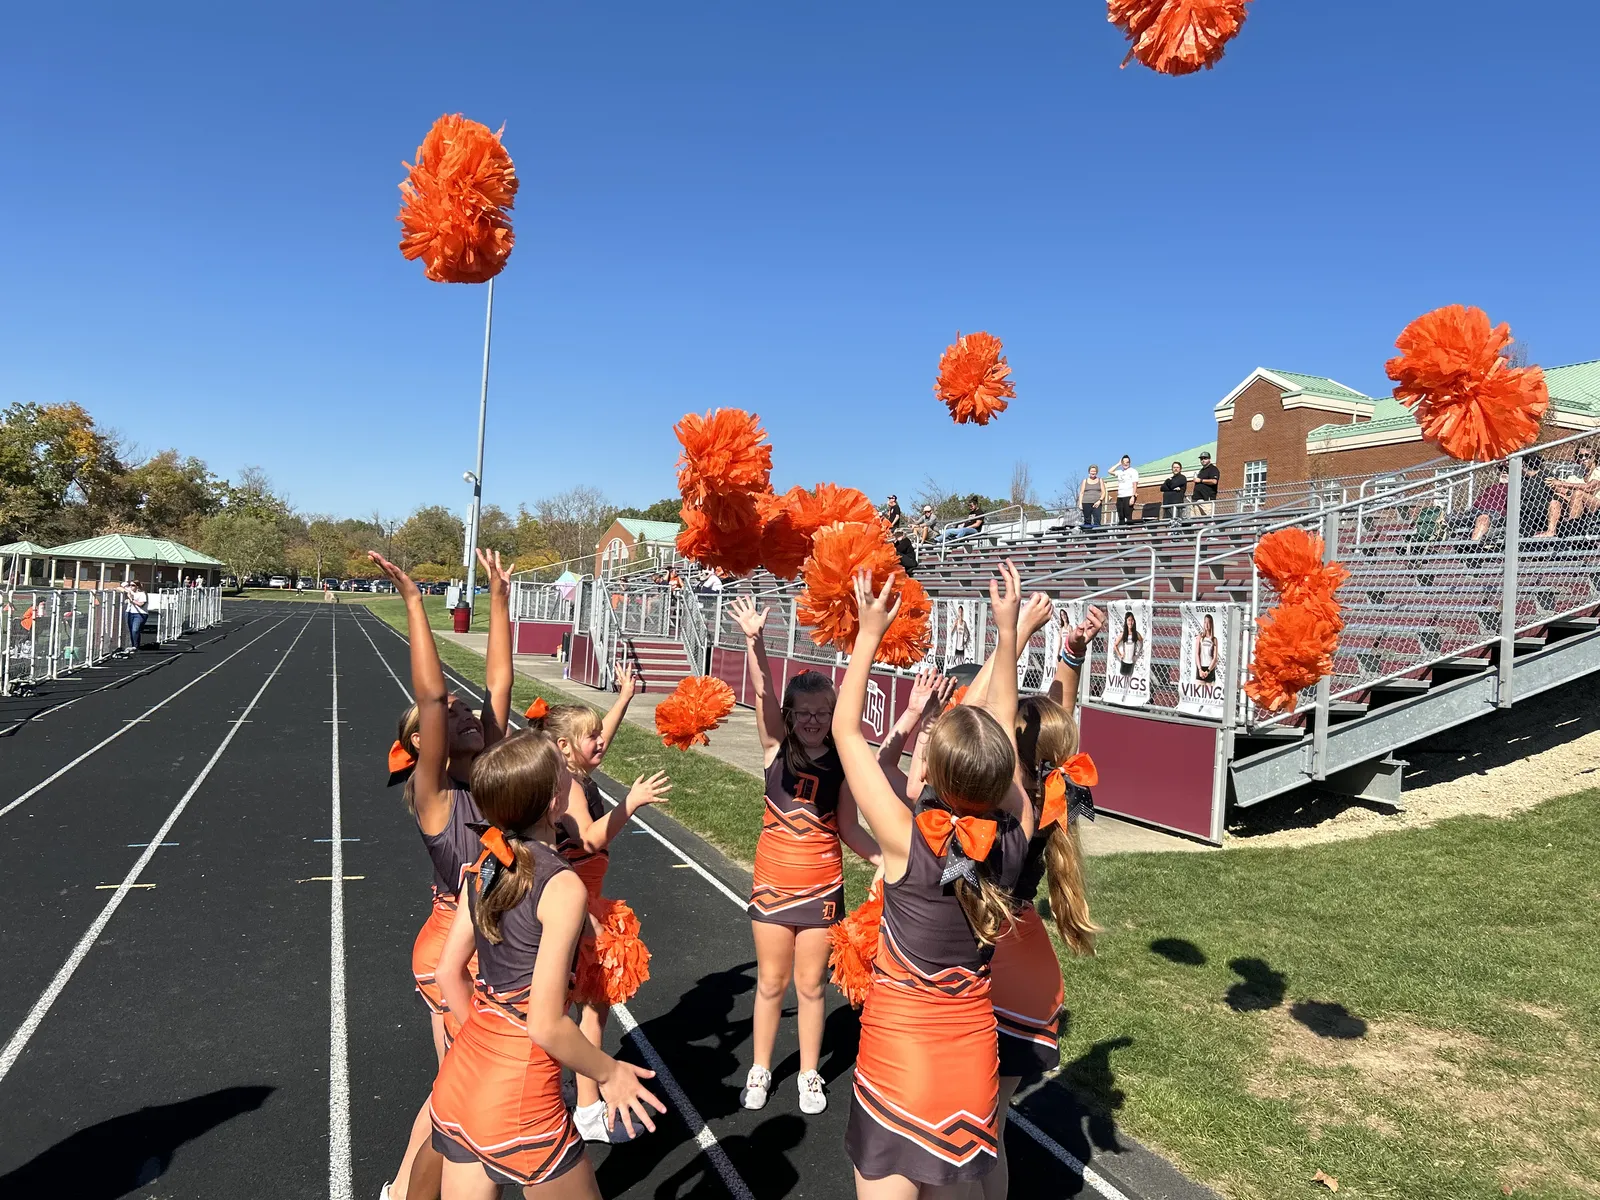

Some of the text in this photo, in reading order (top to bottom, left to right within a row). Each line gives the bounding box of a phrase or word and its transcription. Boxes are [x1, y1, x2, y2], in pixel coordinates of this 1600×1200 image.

[1195, 605, 1216, 613] STEVENS
[1108, 674, 1147, 691] VIKINGS
[792, 771, 819, 804] D
[822, 901, 836, 920] D
